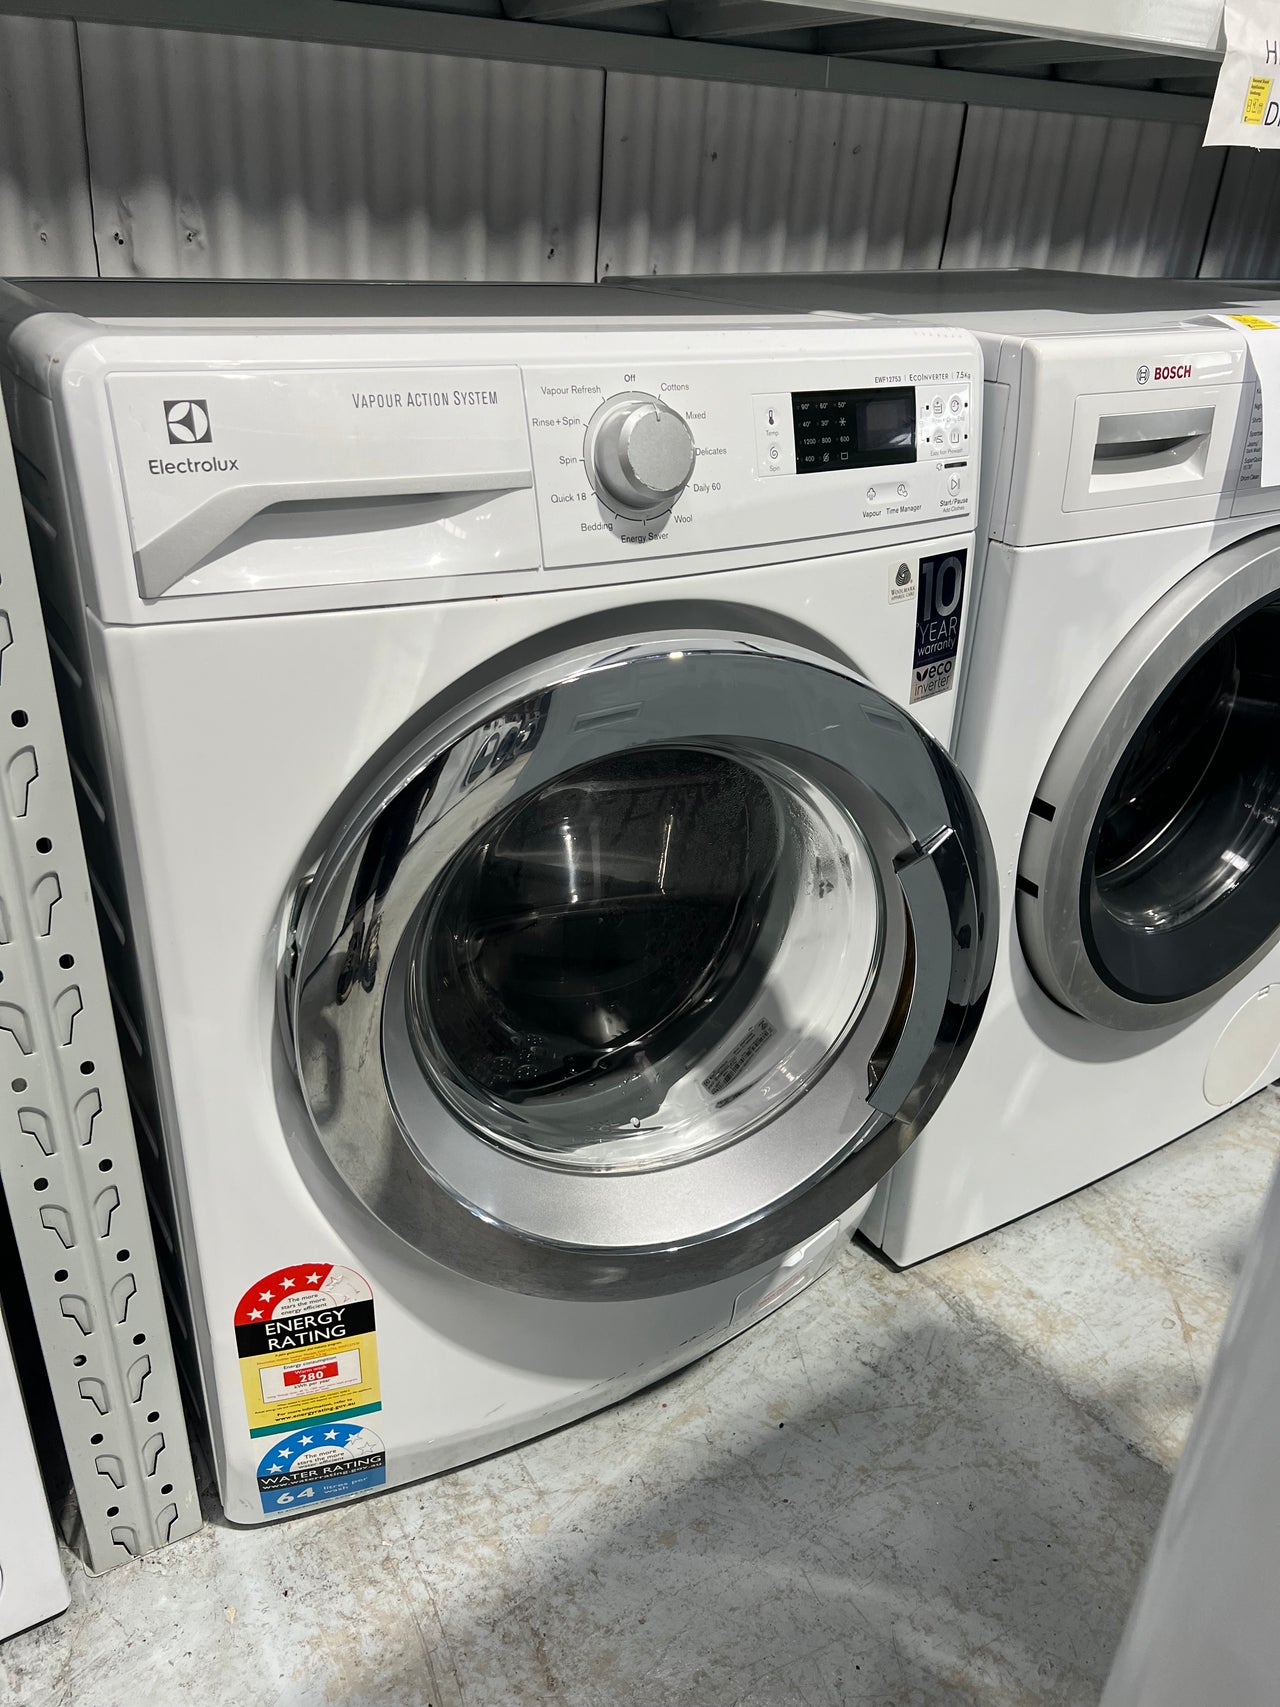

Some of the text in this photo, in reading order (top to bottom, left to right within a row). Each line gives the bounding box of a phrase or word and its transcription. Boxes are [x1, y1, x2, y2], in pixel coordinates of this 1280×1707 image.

[1264, 102, 1280, 126] D
[624, 374, 636, 382] Off
[1154, 365, 1192, 380] BOSCH
[541, 385, 601, 396] Vapour Refresh
[660, 383, 689, 392] Cottons
[686, 412, 706, 420] Mixed
[695, 447, 727, 456] Delicates
[148, 456, 239, 475] Electrolux
[559, 456, 577, 465] Spin
[693, 482, 721, 492] Daily 60
[551, 493, 587, 503] Quick 18
[940, 498, 968, 507] Start/Pause
[674, 515, 692, 523] Wool
[862, 510, 881, 518] Vapour
[581, 522, 613, 532] Bedding
[621, 532, 668, 544] Energy Saver
[922, 556, 962, 621] 10
[919, 616, 958, 644] YEAR
[918, 637, 956, 657] warranty
[928, 660, 952, 677] eco
[914, 674, 950, 696] inverter
[281, 1303, 327, 1316] energy efficient
[265, 1308, 346, 1336] ENERGY
[268, 1324, 346, 1351] RATING
[303, 1356, 336, 1366] consumption
[299, 1371, 323, 1382] 280
[275, 1402, 356, 1422] www.energyrating.gov.au
[261, 1455, 382, 1485] WATER RATING
[263, 1462, 382, 1490] www.waterrating.gov.au
[323, 1477, 368, 1490] litres per
[276, 1487, 315, 1505] 64
[324, 1486, 349, 1494] wash
